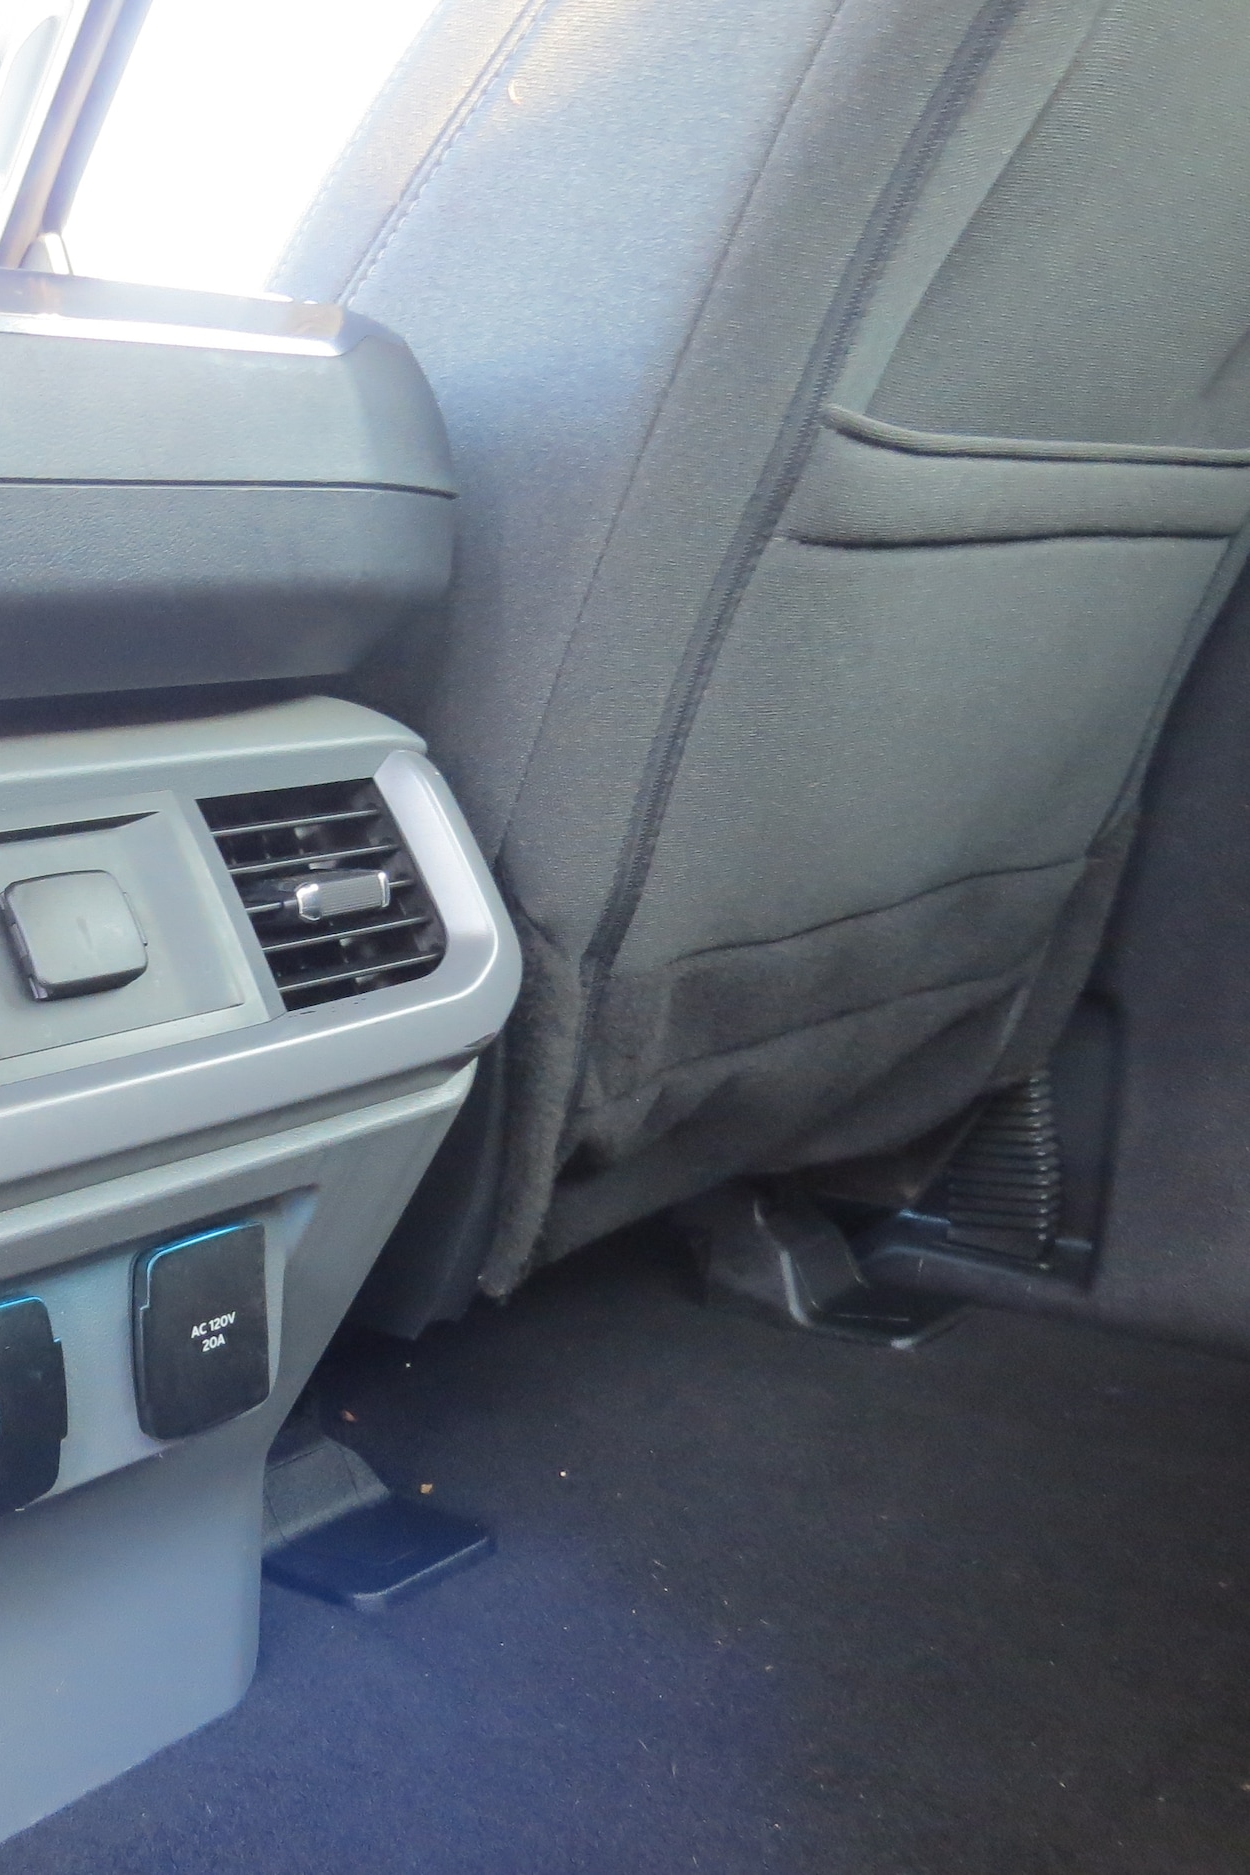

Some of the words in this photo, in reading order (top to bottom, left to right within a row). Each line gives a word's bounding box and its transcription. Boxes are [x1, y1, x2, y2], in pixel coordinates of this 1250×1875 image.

[191, 1322, 208, 1339] AC
[209, 1311, 236, 1331] 120V
[202, 1333, 226, 1352] 20A
